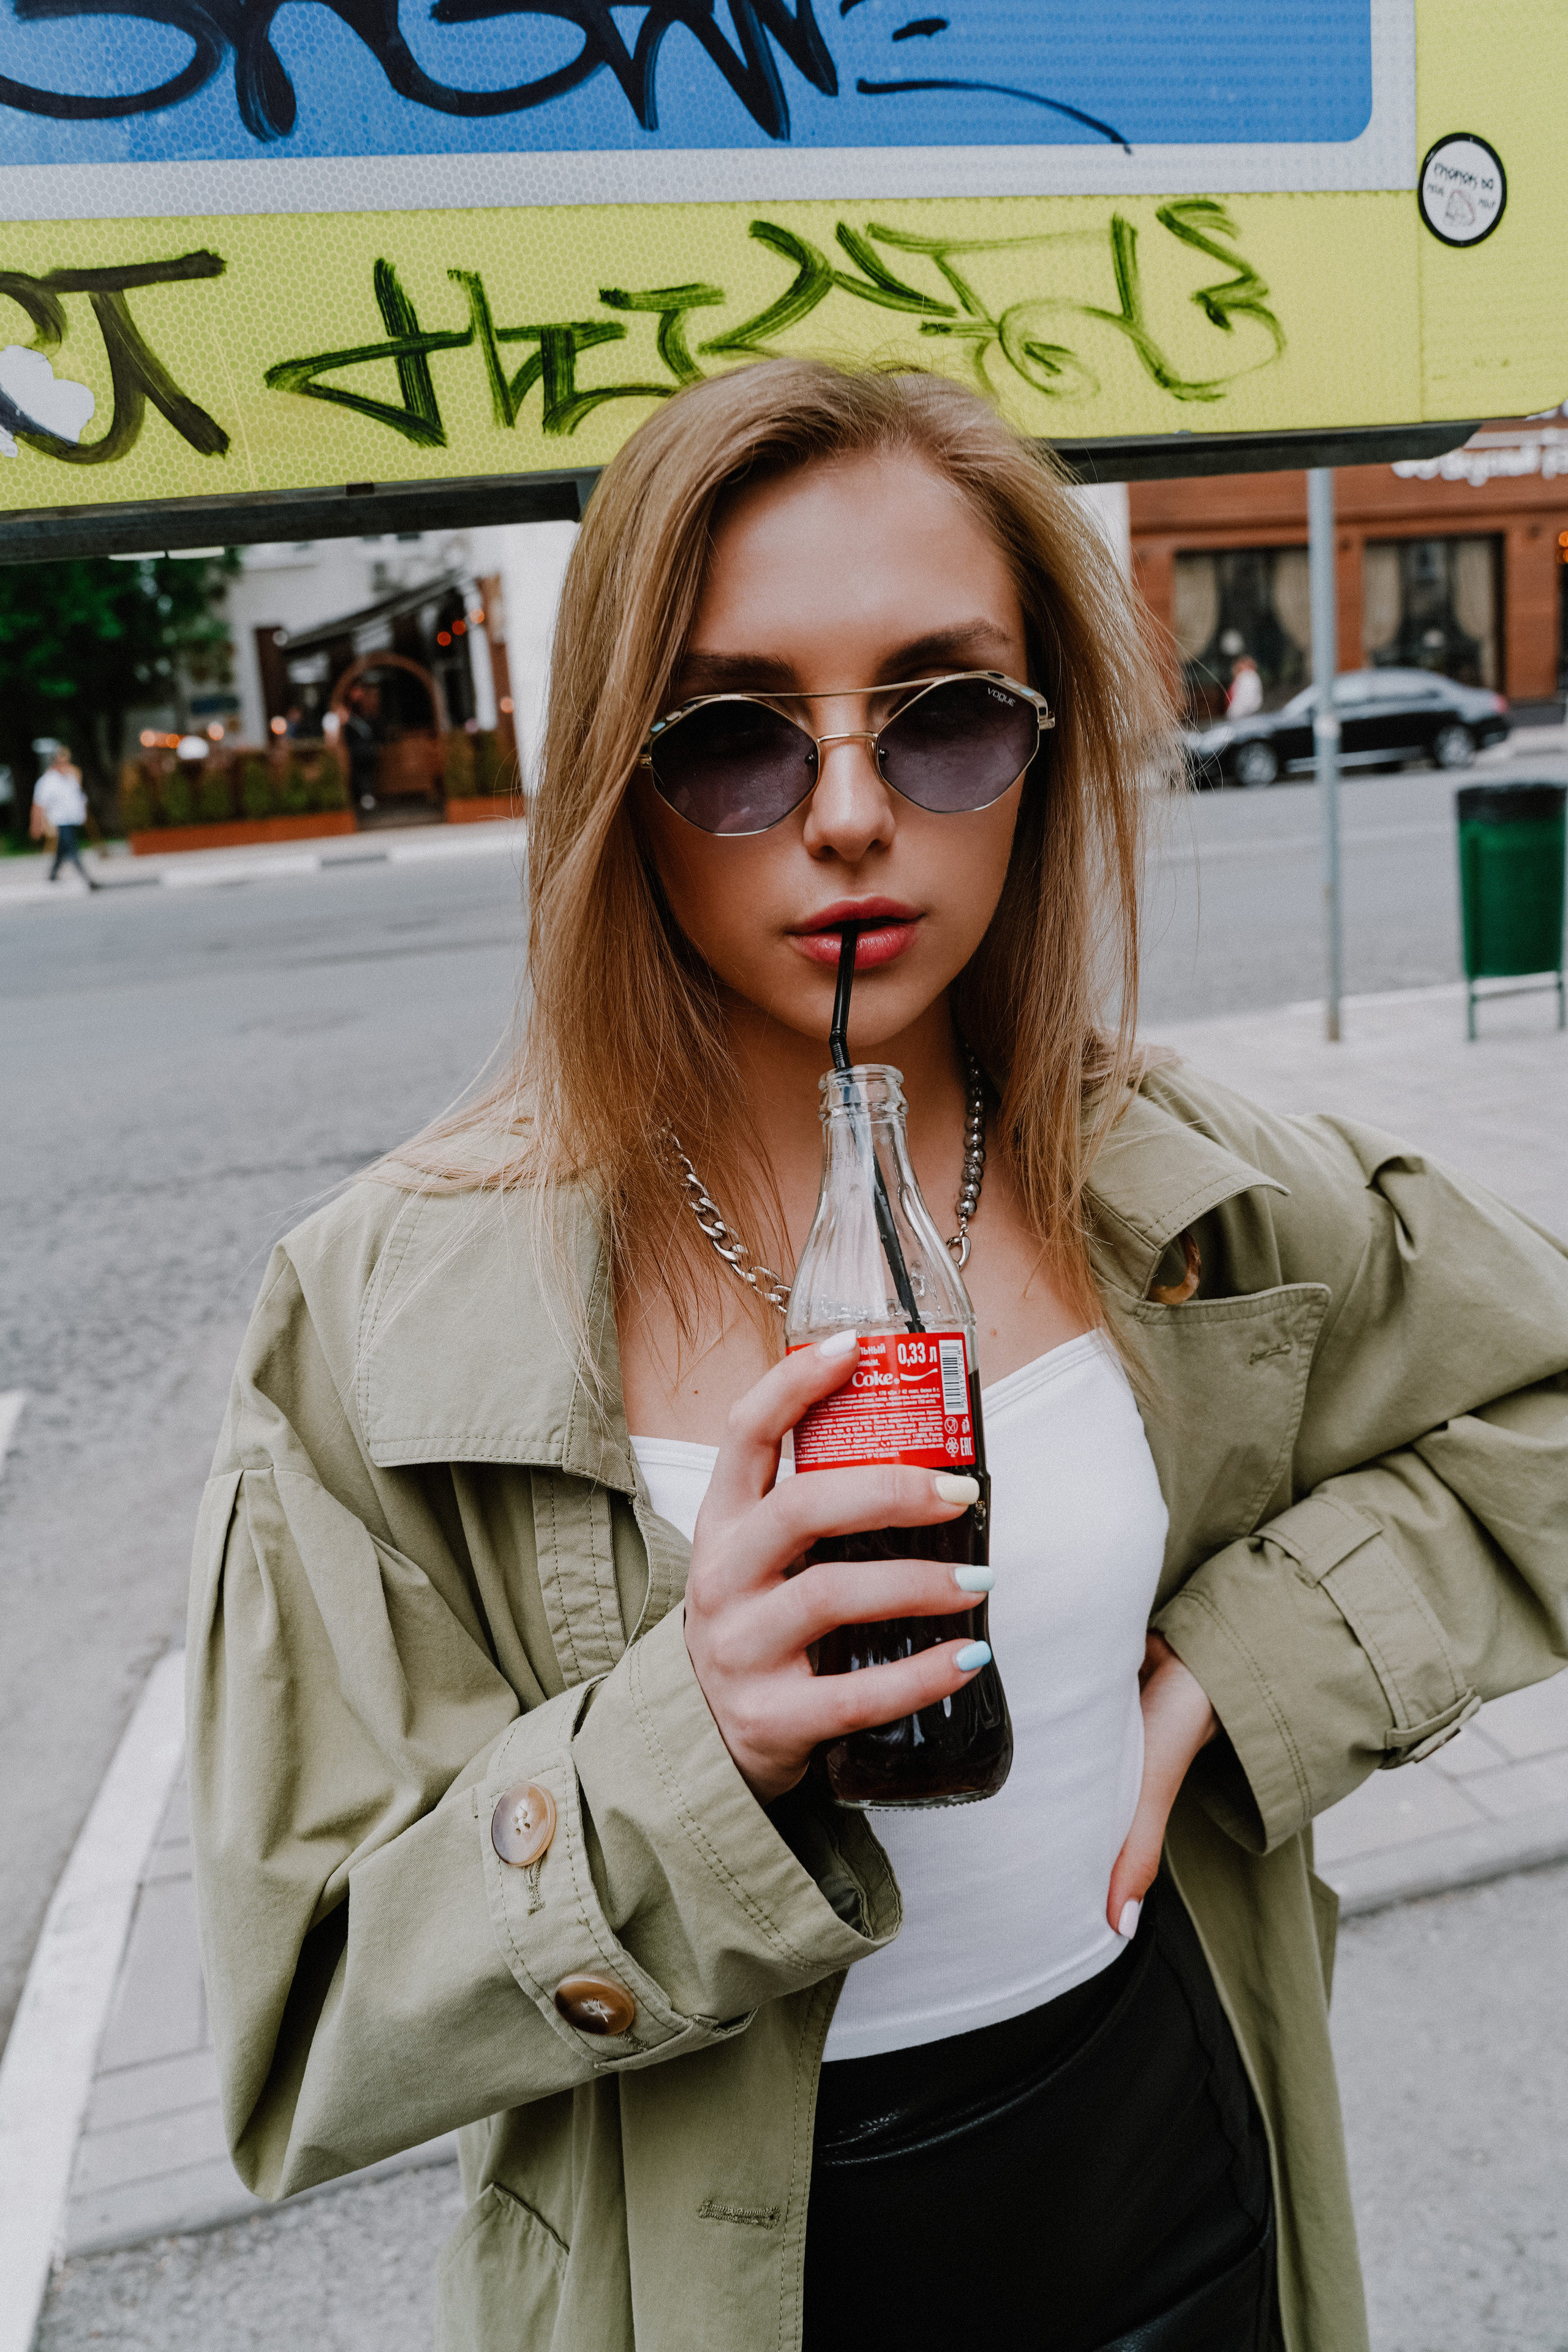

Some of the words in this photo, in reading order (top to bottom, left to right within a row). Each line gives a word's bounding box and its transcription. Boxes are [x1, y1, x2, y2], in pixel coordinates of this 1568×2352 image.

[988, 687, 1016, 707] VOGUE
[897, 1342, 926, 1367] 0,33
[929, 1346, 938, 1363] л
